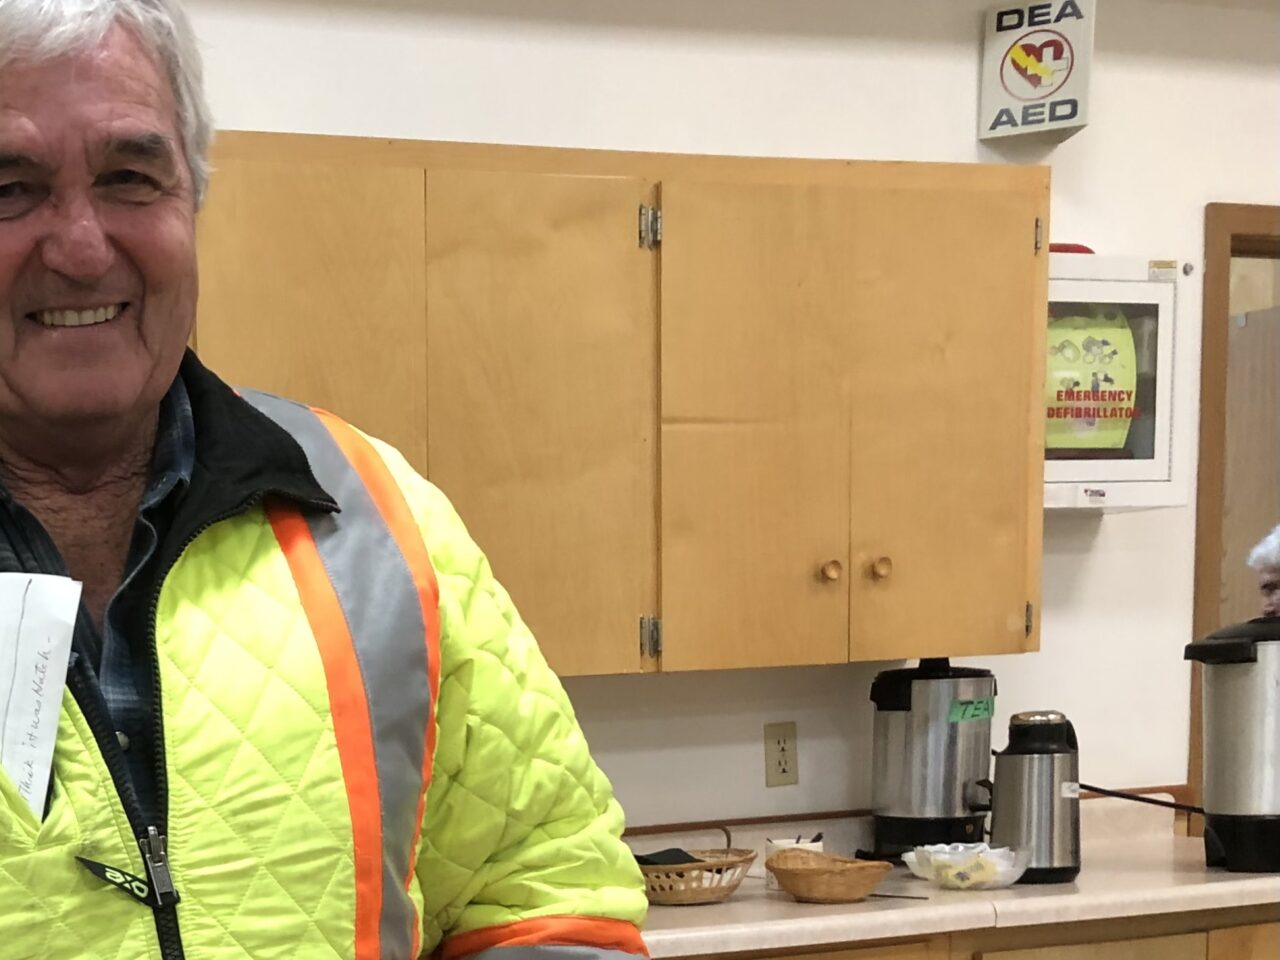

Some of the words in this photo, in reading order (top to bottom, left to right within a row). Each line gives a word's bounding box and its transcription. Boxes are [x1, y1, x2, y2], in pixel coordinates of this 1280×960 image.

[996, 0, 1084, 32] DEA
[988, 98, 1078, 131] AED
[1056, 390, 1133, 402] EMERGENCY
[960, 700, 991, 718] TEA
